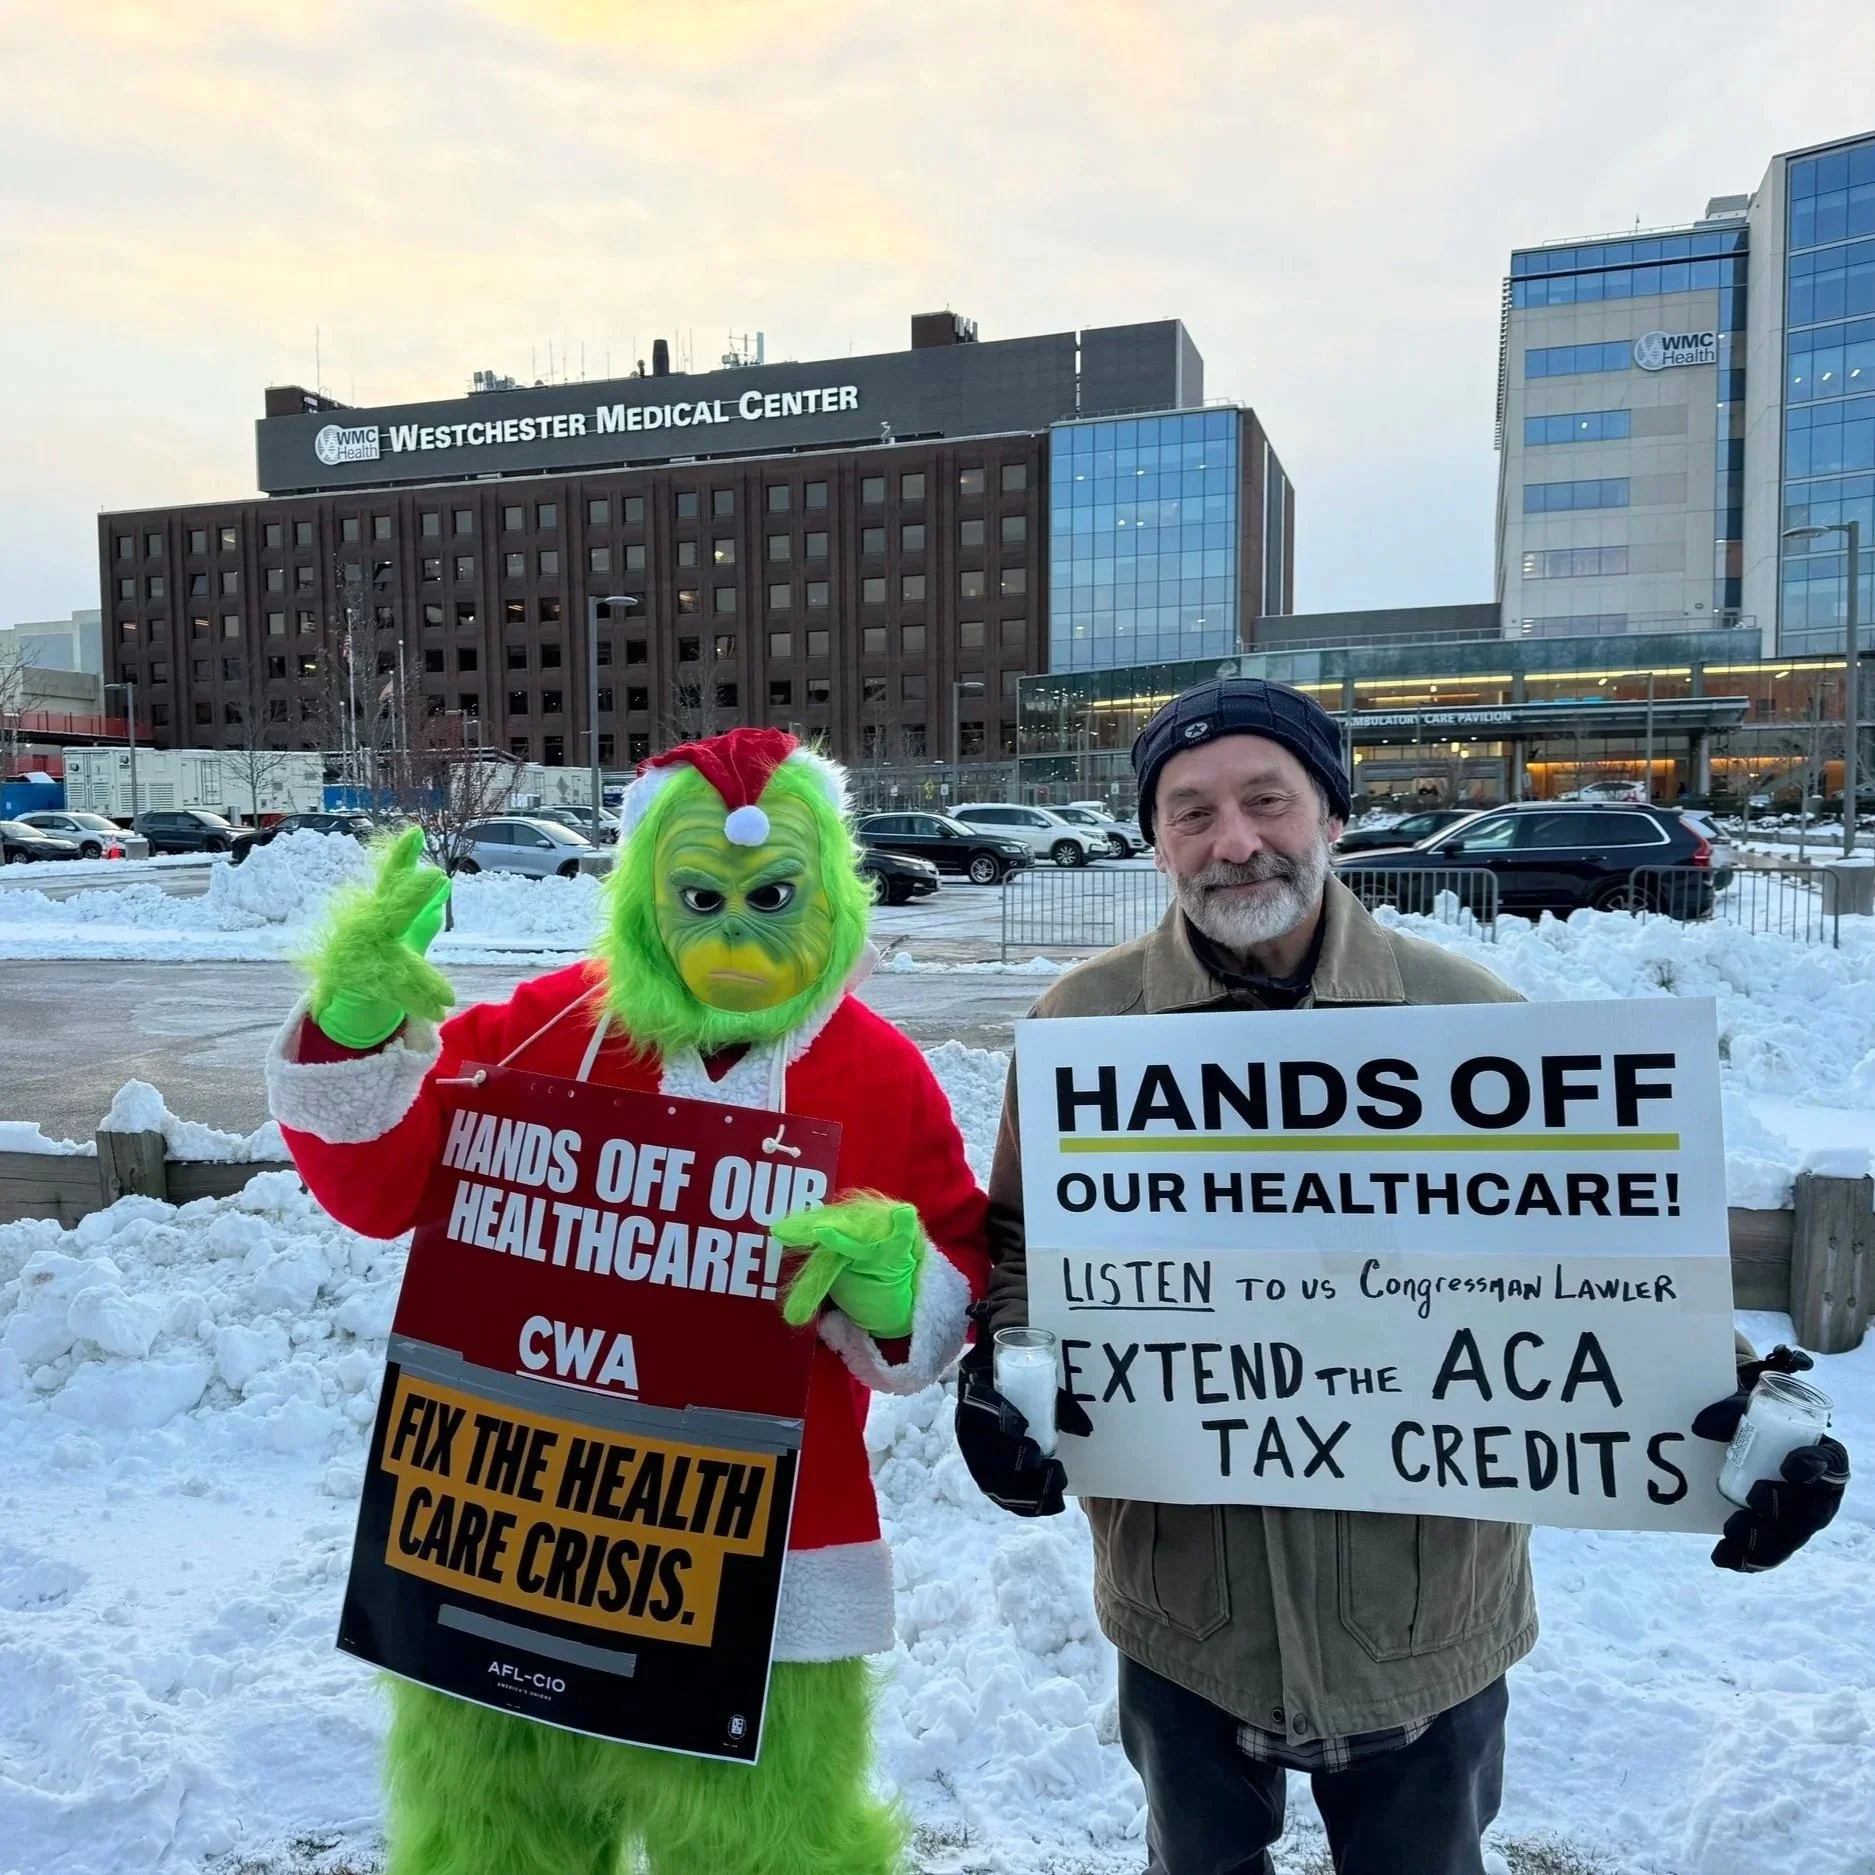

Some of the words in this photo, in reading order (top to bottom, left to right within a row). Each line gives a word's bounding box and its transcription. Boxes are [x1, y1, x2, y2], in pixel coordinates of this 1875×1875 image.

[1662, 333, 1714, 350] WMC
[1662, 348, 1715, 365] Health
[336, 429, 377, 446] WMC
[338, 443, 378, 459] Health
[1424, 713, 1457, 724] CARE
[1458, 711, 1512, 723] PAVILION
[1055, 1058, 1423, 1132] HANDS
[1450, 1053, 1676, 1129] OFF
[441, 1109, 582, 1194] HANDS
[595, 1138, 696, 1212] OFF
[709, 1155, 828, 1227] OUR
[1056, 1172, 1188, 1213] OUR
[1203, 1172, 1681, 1216] HEALTHCARE!
[446, 1180, 784, 1300] HEALTHCARE!
[1063, 1257, 1211, 1305] LISTEN
[1235, 1278, 1286, 1301] TO
[1554, 1264, 1677, 1302] LAWLER
[518, 1315, 639, 1391] CWA
[1062, 1339, 1303, 1404] EXTEND
[1315, 1366, 1402, 1396] THE
[1432, 1328, 1623, 1408] ACA
[390, 1393, 468, 1477] FIX
[465, 1413, 558, 1502] THE
[555, 1437, 766, 1540] HEALTH
[1201, 1416, 1351, 1479] TAX
[1391, 1420, 1688, 1505] CREDITS
[399, 1486, 518, 1584] CARE
[516, 1521, 696, 1626] CRISIS.
[488, 1661, 566, 1692] AFL-CIO
